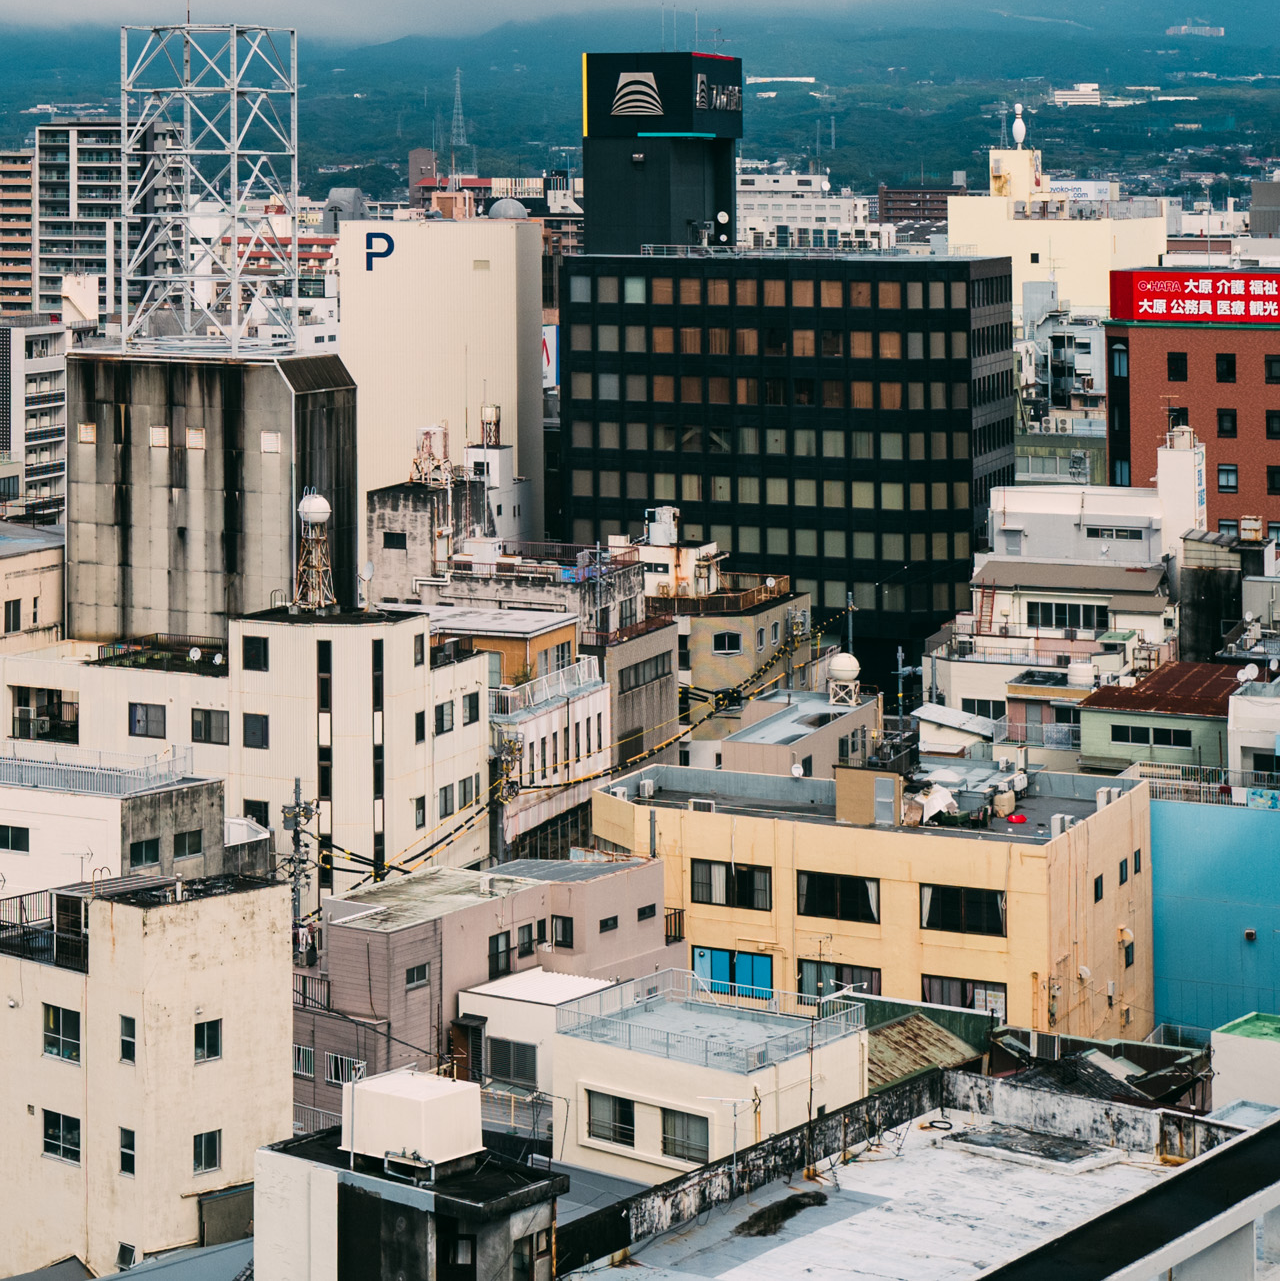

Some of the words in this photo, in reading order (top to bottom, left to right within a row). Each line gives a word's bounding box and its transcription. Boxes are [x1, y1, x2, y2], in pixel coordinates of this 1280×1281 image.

[365, 232, 394, 271] P
[1184, 279, 1213, 294] 大原
[1216, 279, 1245, 295] 介護
[1249, 280, 1278, 295] 福祉
[1138, 298, 1167, 314] 大原
[1170, 299, 1213, 315] 公務員
[1216, 300, 1245, 315] 医療
[1249, 300, 1278, 316] 観光
